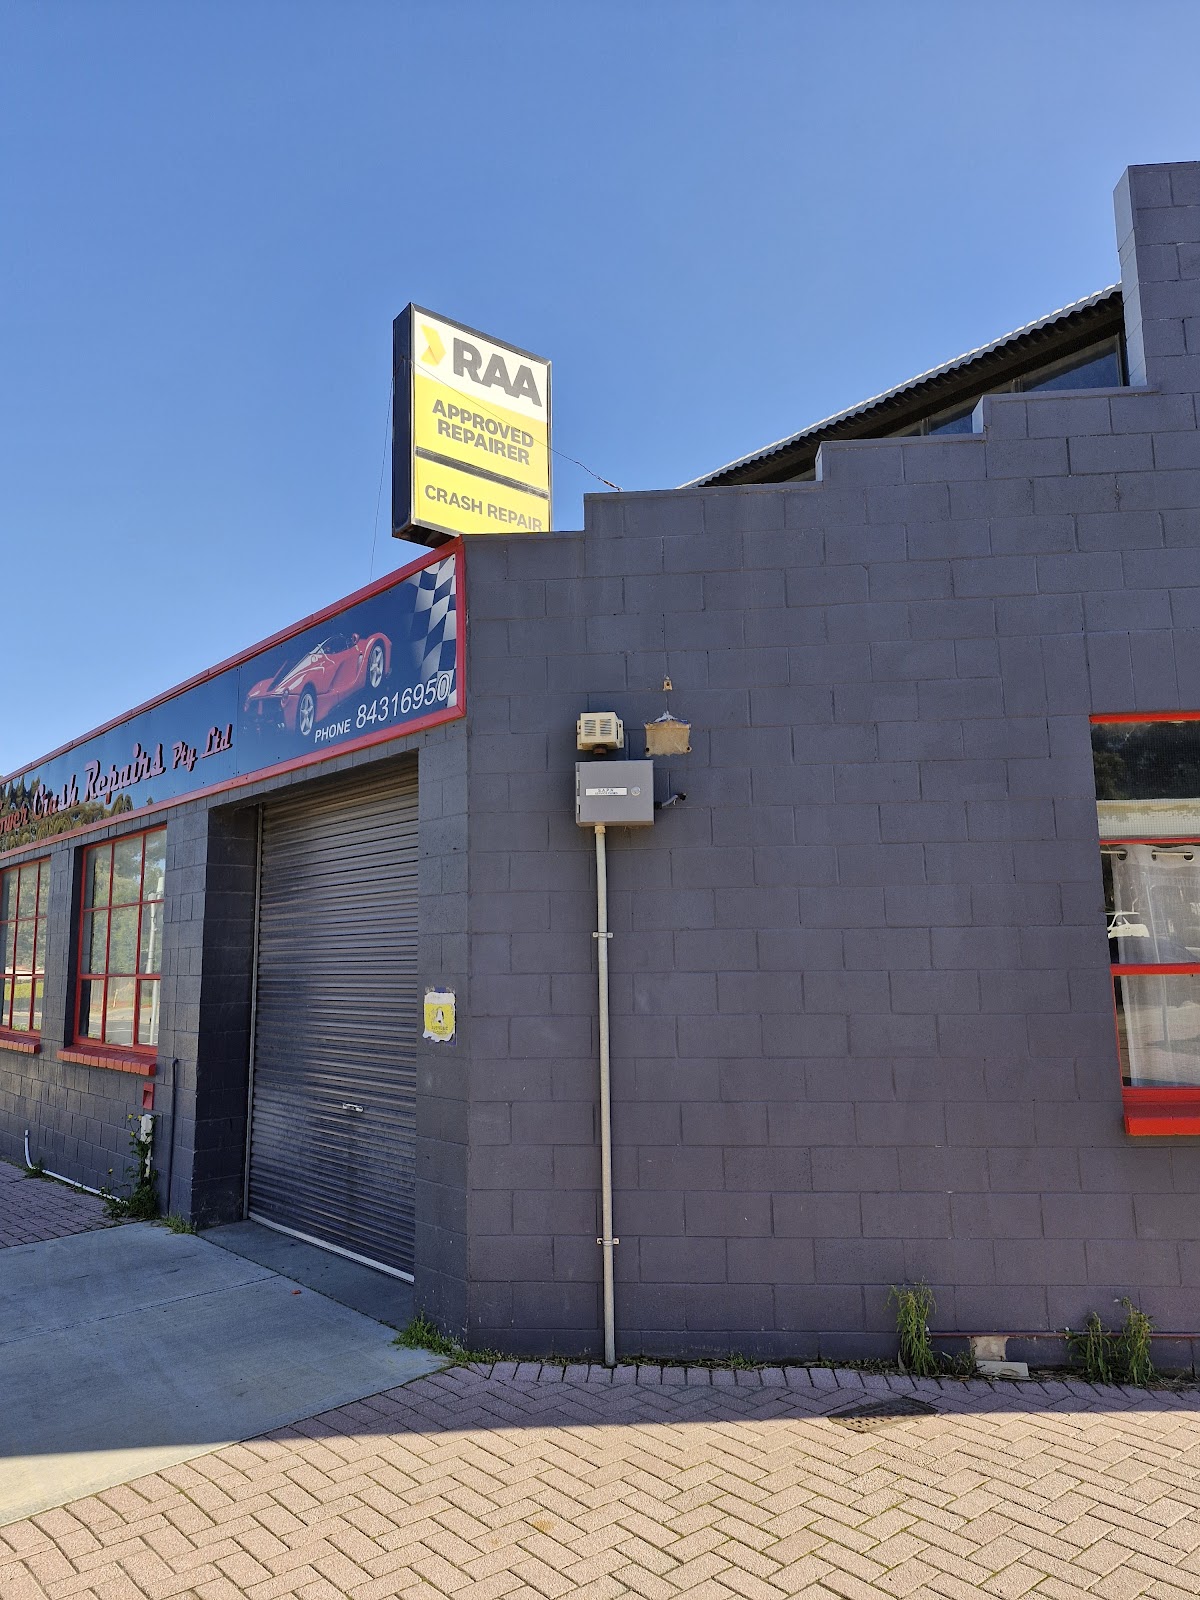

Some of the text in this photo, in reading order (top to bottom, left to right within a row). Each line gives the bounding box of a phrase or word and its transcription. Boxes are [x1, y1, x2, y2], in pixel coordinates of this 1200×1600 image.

[453, 337, 543, 408] RAA
[432, 399, 534, 448] APPROVED
[437, 418, 531, 466] REPAIRER
[424, 484, 543, 532] CRASH REPAIR
[314, 673, 451, 744] PHONE 84316950
[32, 773, 80, 821] Crash
[84, 742, 167, 805] Repairs
[172, 740, 199, 772] Pty
[201, 723, 234, 759] Ltd
